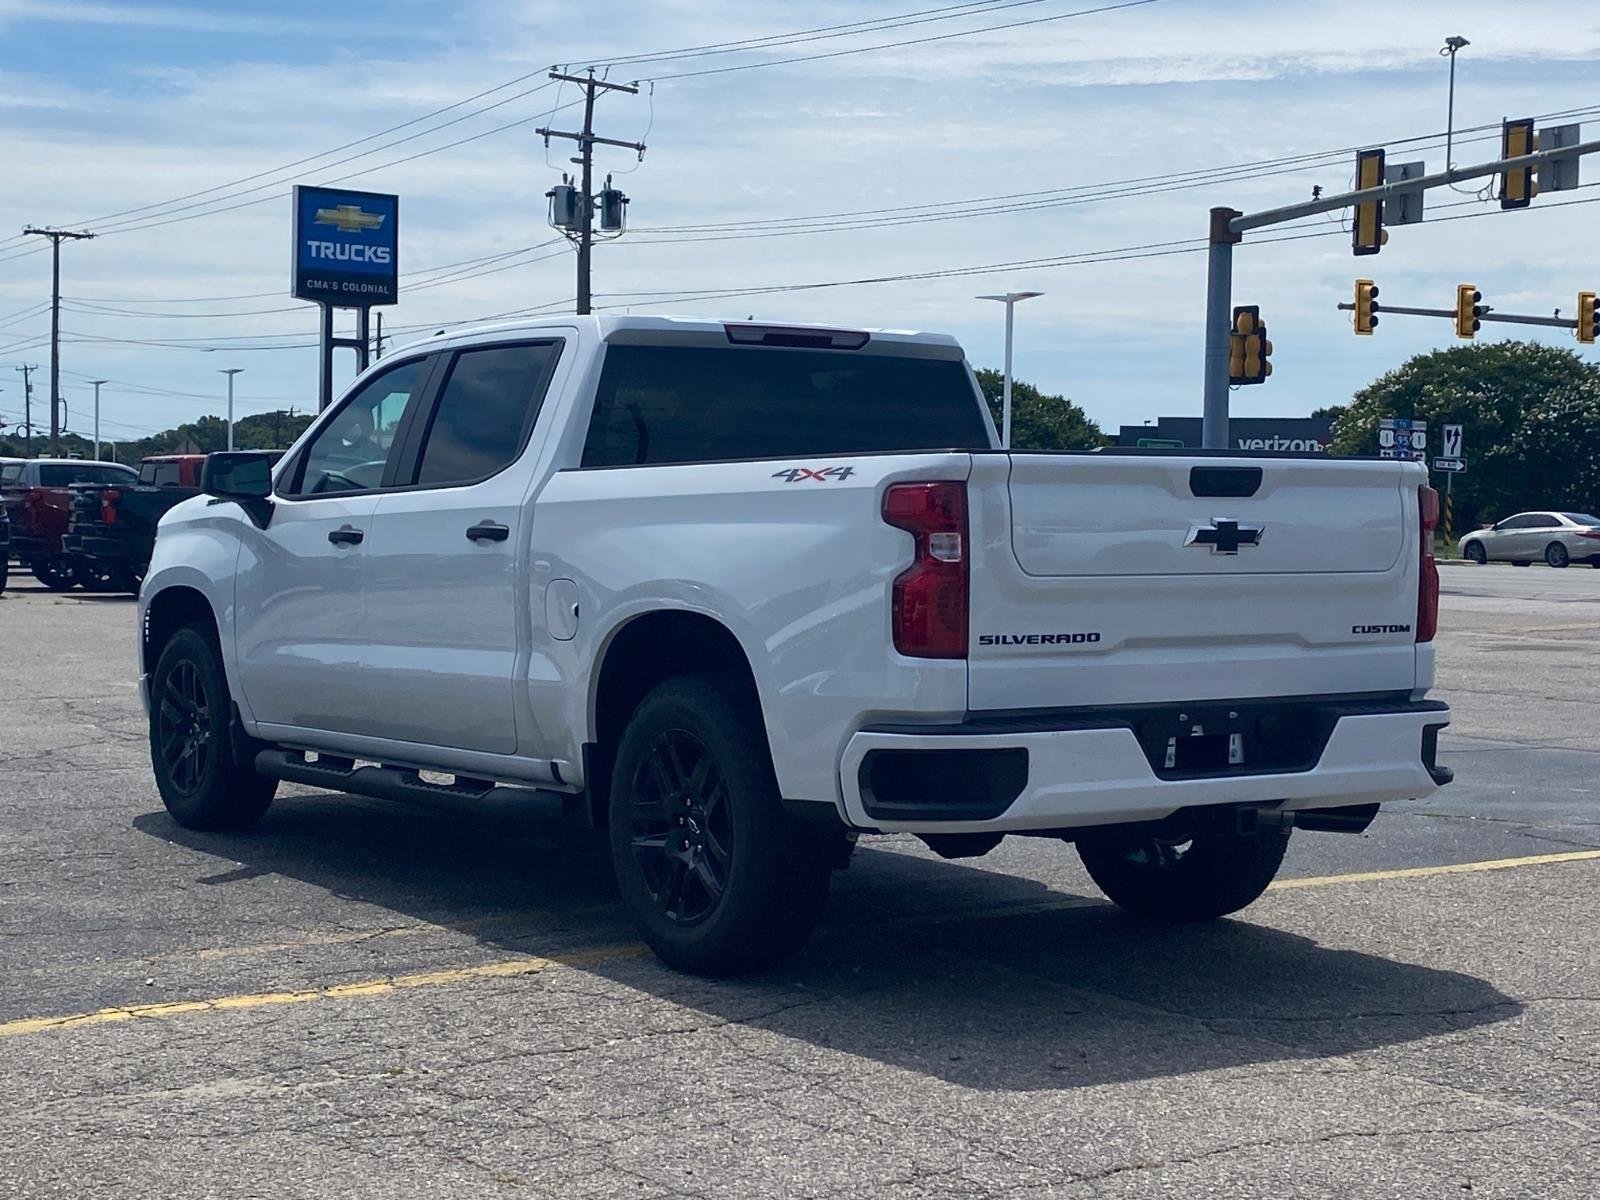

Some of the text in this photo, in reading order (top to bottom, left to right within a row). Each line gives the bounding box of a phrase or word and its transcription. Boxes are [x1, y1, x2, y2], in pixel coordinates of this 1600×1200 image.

[307, 240, 390, 264] TRUCKS
[306, 279, 389, 294] CMA'S COLONIAL
[1238, 435, 1319, 451] verizon
[1397, 435, 1408, 446] 95
[1352, 625, 1411, 634] CUSTOM
[979, 633, 1101, 645] SILVERADO
